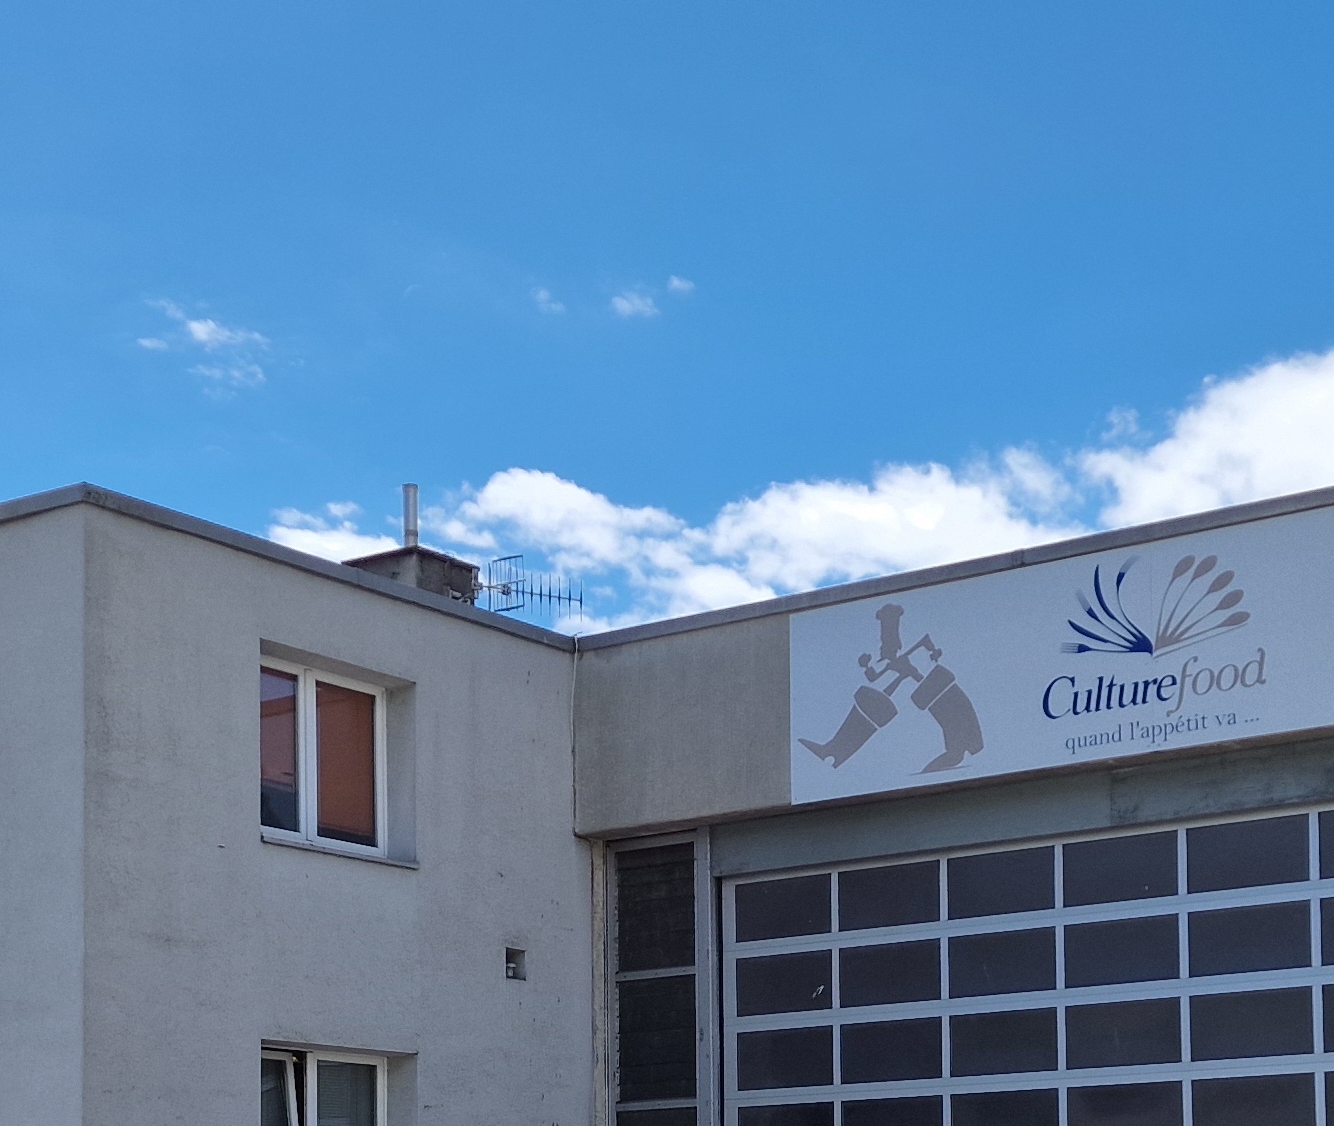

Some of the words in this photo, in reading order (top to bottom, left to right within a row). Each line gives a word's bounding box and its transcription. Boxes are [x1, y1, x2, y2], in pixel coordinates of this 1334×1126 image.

[1042, 647, 1267, 719] Culturefood
[1065, 724, 1123, 755] quand
[1130, 712, 1208, 743] l'appétit
[1215, 711, 1237, 727] va
